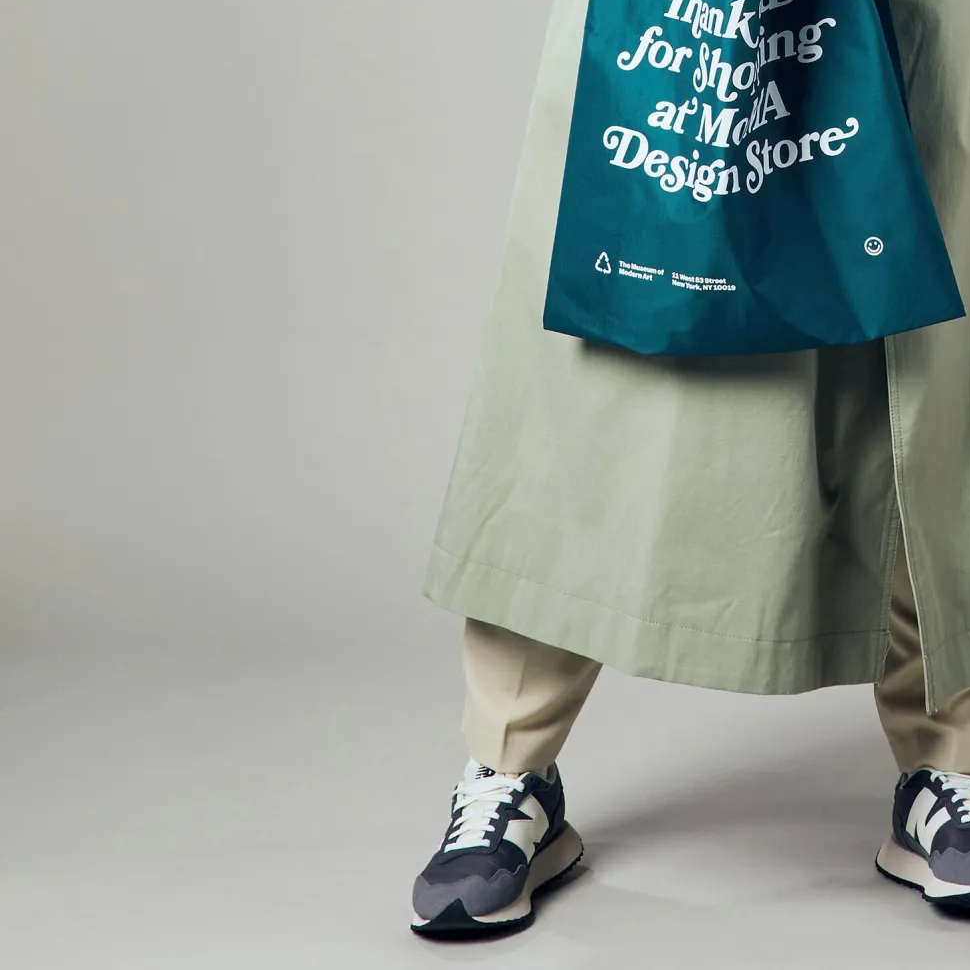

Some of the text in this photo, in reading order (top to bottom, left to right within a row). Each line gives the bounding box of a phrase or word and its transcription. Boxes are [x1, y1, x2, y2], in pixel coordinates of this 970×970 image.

[616, 17, 836, 102] for Shoing
[647, 97, 698, 134] at
[602, 117, 860, 203] Design Store
[619, 260, 631, 269] The
[631, 263, 657, 274] Museum
[619, 268, 653, 281] Modern Art
[680, 274, 695, 282] West
[671, 279, 686, 288] New
[685, 282, 702, 291] York,
